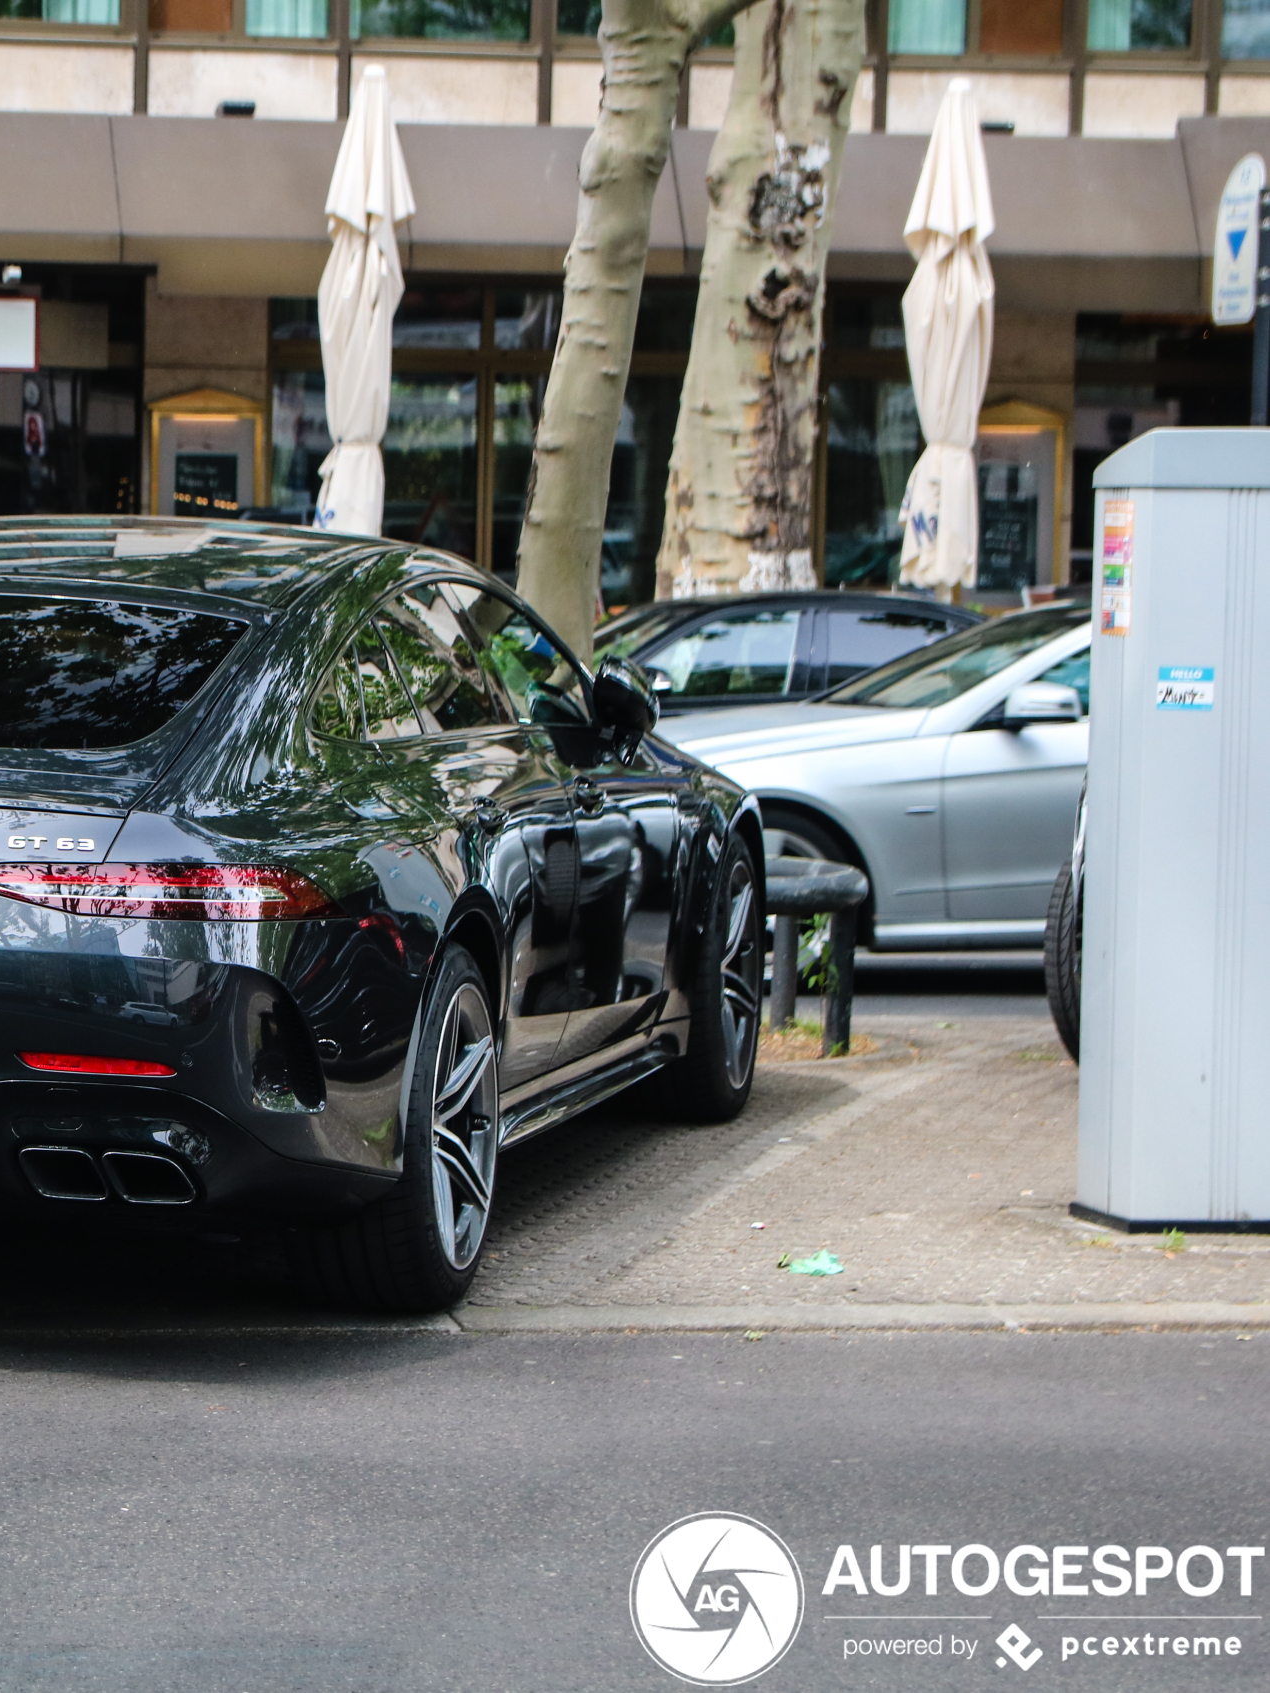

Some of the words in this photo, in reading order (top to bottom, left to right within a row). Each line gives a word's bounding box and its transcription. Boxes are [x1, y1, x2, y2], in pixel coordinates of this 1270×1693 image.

[1170, 668, 1204, 680] HELLO
[7, 835, 48, 850] GT
[56, 837, 95, 852] 63
